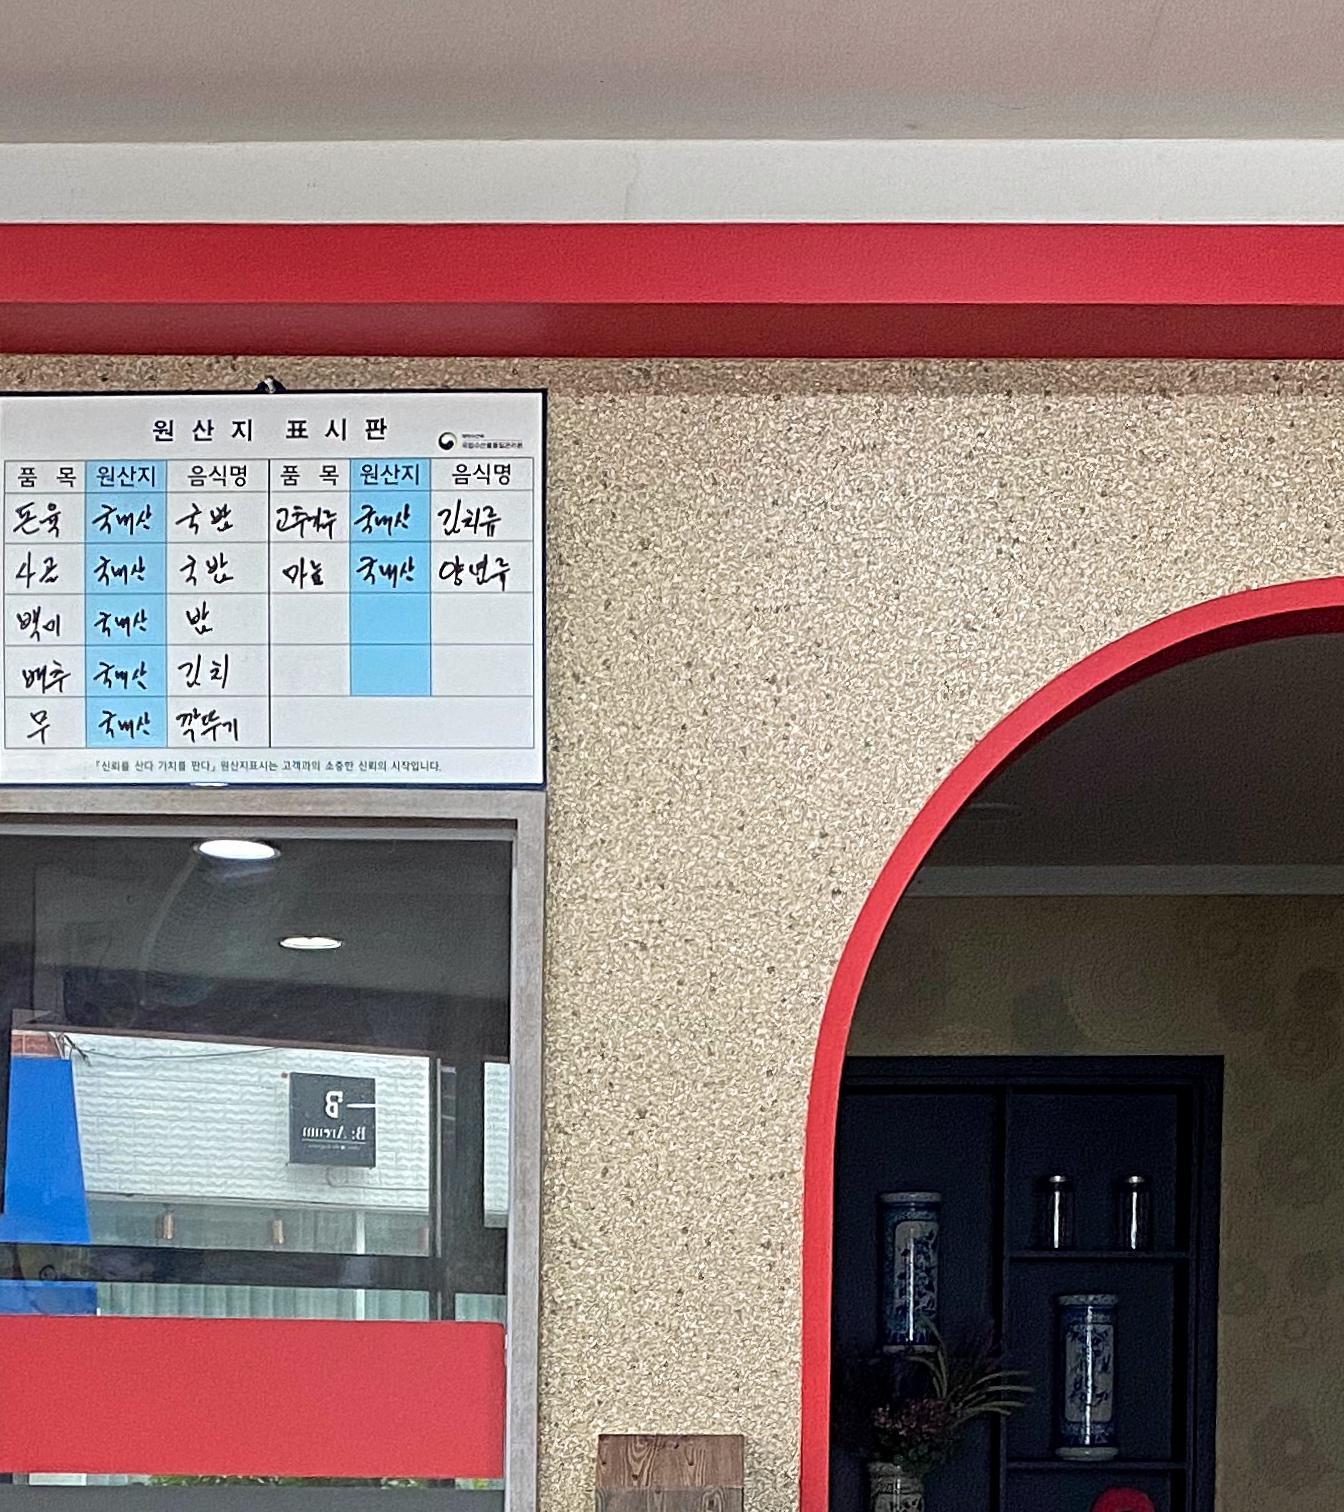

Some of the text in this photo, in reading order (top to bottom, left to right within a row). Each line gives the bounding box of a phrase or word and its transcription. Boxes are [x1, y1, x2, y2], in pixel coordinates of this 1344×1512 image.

[153, 417, 389, 442] 원산지 표시판
[17, 466, 77, 488] 품목
[96, 465, 156, 487] 원산지
[187, 465, 248, 487] 음식명
[280, 464, 340, 486] 품목
[359, 463, 420, 486] 원산지
[452, 463, 512, 486] 음식명
[92, 503, 153, 536] 국내산
[354, 503, 411, 536] 국내산
[437, 498, 502, 537] 김치류
[93, 555, 146, 587] 국내산
[356, 555, 415, 588] 국내산
[94, 608, 148, 637] 국내산
[186, 600, 213, 636] 밥
[22, 659, 72, 694] 배추
[93, 661, 148, 690] 국내산
[177, 653, 229, 689] 김치
[27, 709, 51, 745] 무
[98, 709, 152, 740] 국내산
[135, 760, 154, 772] 산다
[220, 760, 278, 772] 원산지표시는
[282, 760, 320, 772] 고객과의
[325, 760, 354, 772] 소중한
[358, 760, 387, 772] 신뢰의
